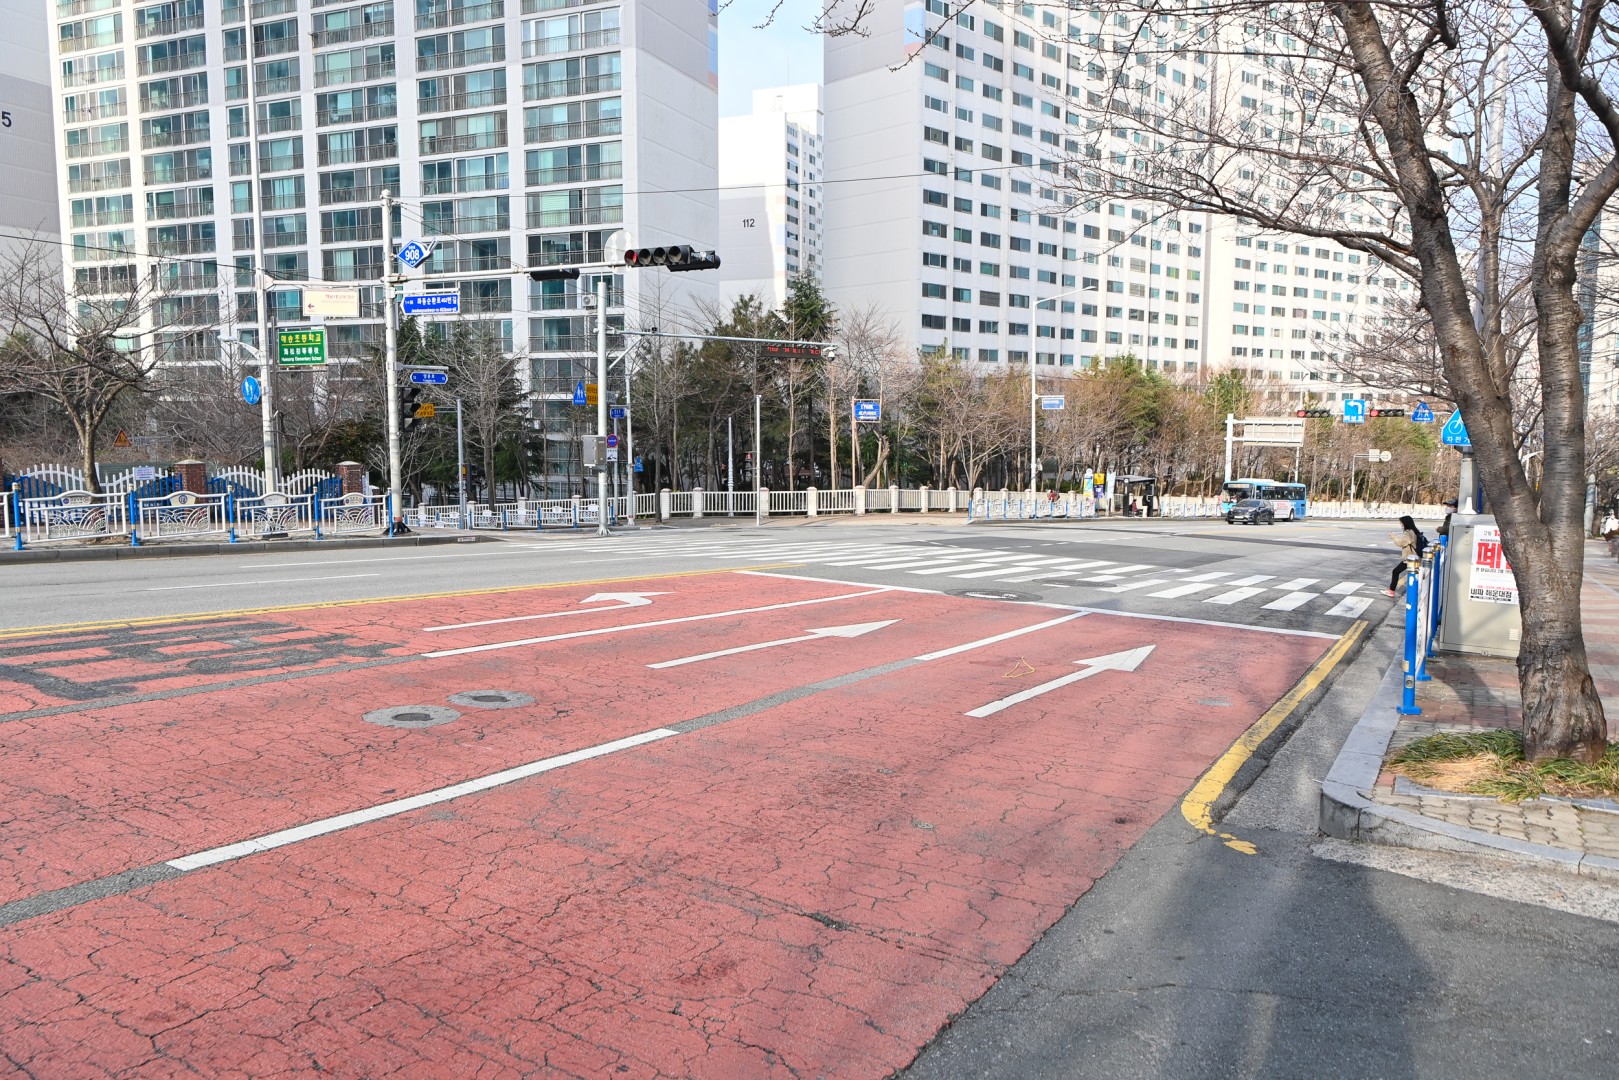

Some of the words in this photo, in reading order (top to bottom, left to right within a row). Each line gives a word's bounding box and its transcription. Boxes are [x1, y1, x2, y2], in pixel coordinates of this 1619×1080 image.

[2, 110, 12, 128] 5
[742, 218, 755, 228] 112
[404, 249, 420, 261] 908
[1476, 542, 1513, 570] 폐
